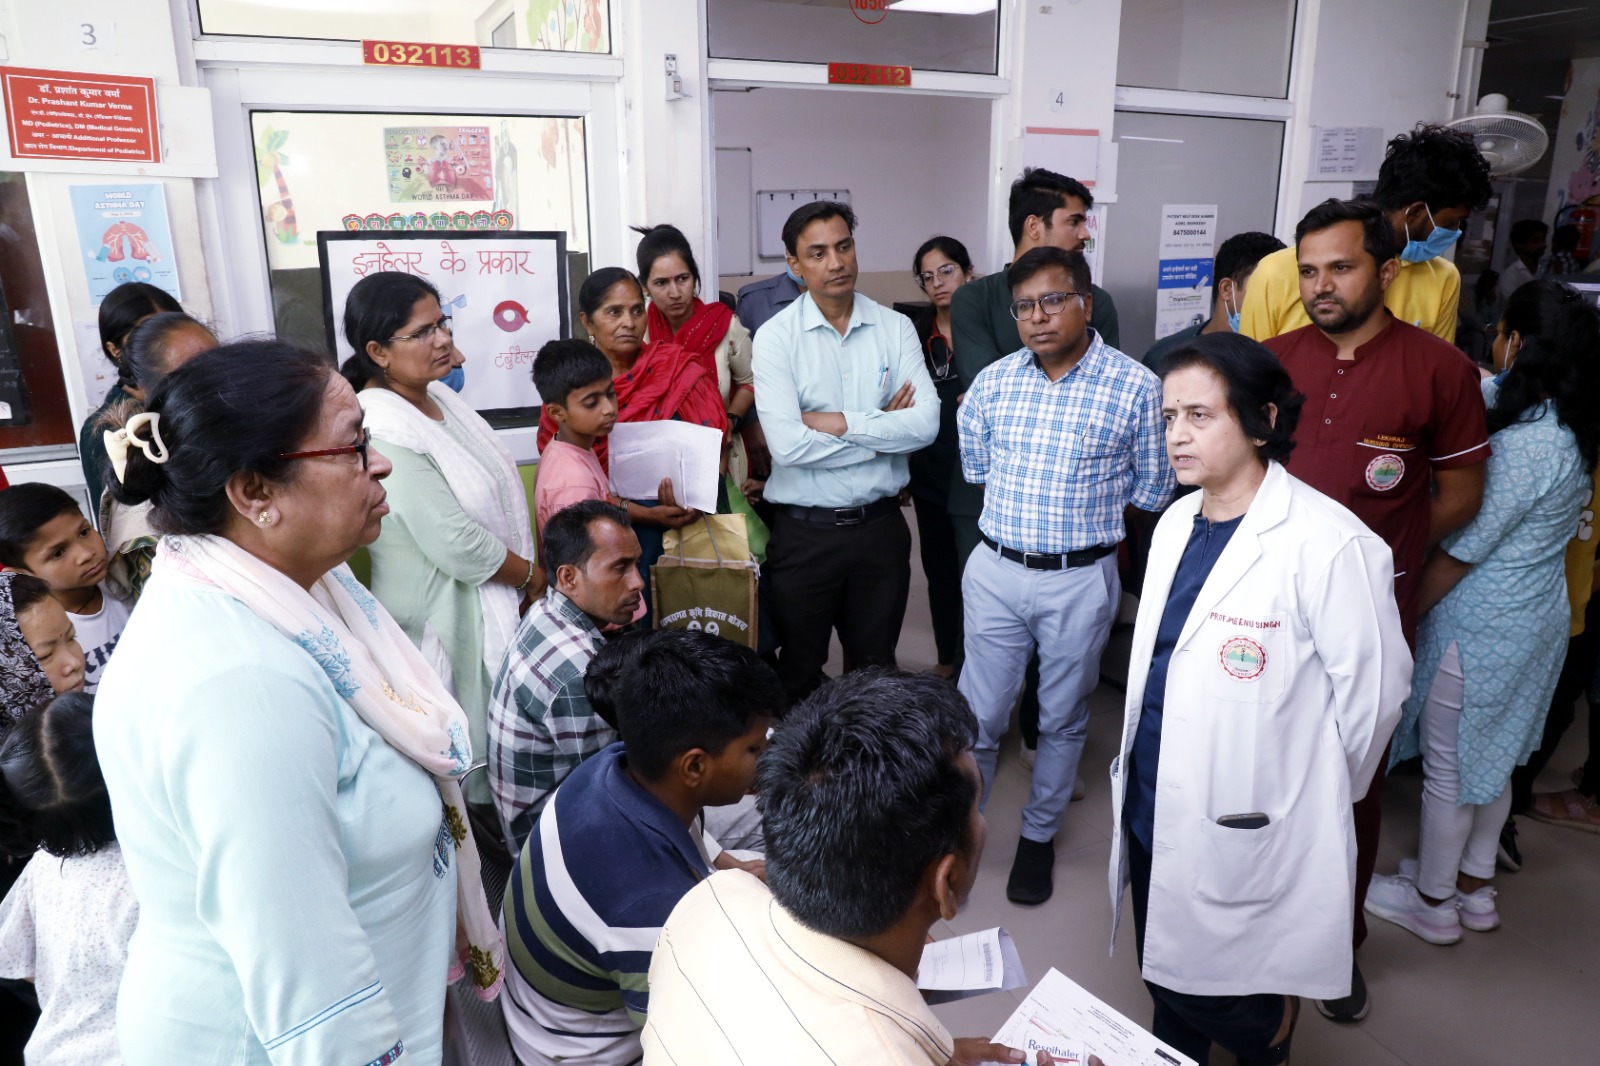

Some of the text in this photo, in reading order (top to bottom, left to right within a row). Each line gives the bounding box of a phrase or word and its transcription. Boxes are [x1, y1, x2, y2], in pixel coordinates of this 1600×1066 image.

[80, 23, 97, 46] 3
[373, 43, 471, 66] 032113
[836, 65, 905, 84] 032112
[80, 87, 102, 99] कुमार
[1055, 91, 1065, 106] 4
[28, 96, 133, 111] Dr. Prashant Kumar Verma
[87, 123, 113, 132] (Medical
[114, 125, 143, 134] Genetics)
[73, 134, 105, 142] Additional
[106, 136, 137, 144] Professor
[105, 192, 132, 200] WORLD
[129, 201, 145, 209] DAY
[352, 240, 536, 278] इनहेलर के प्रकार
[688, 607, 703, 620] कृषि
[1255, 620, 1281, 629] SINGH
[1027, 1038, 1080, 1060] Respihaler
